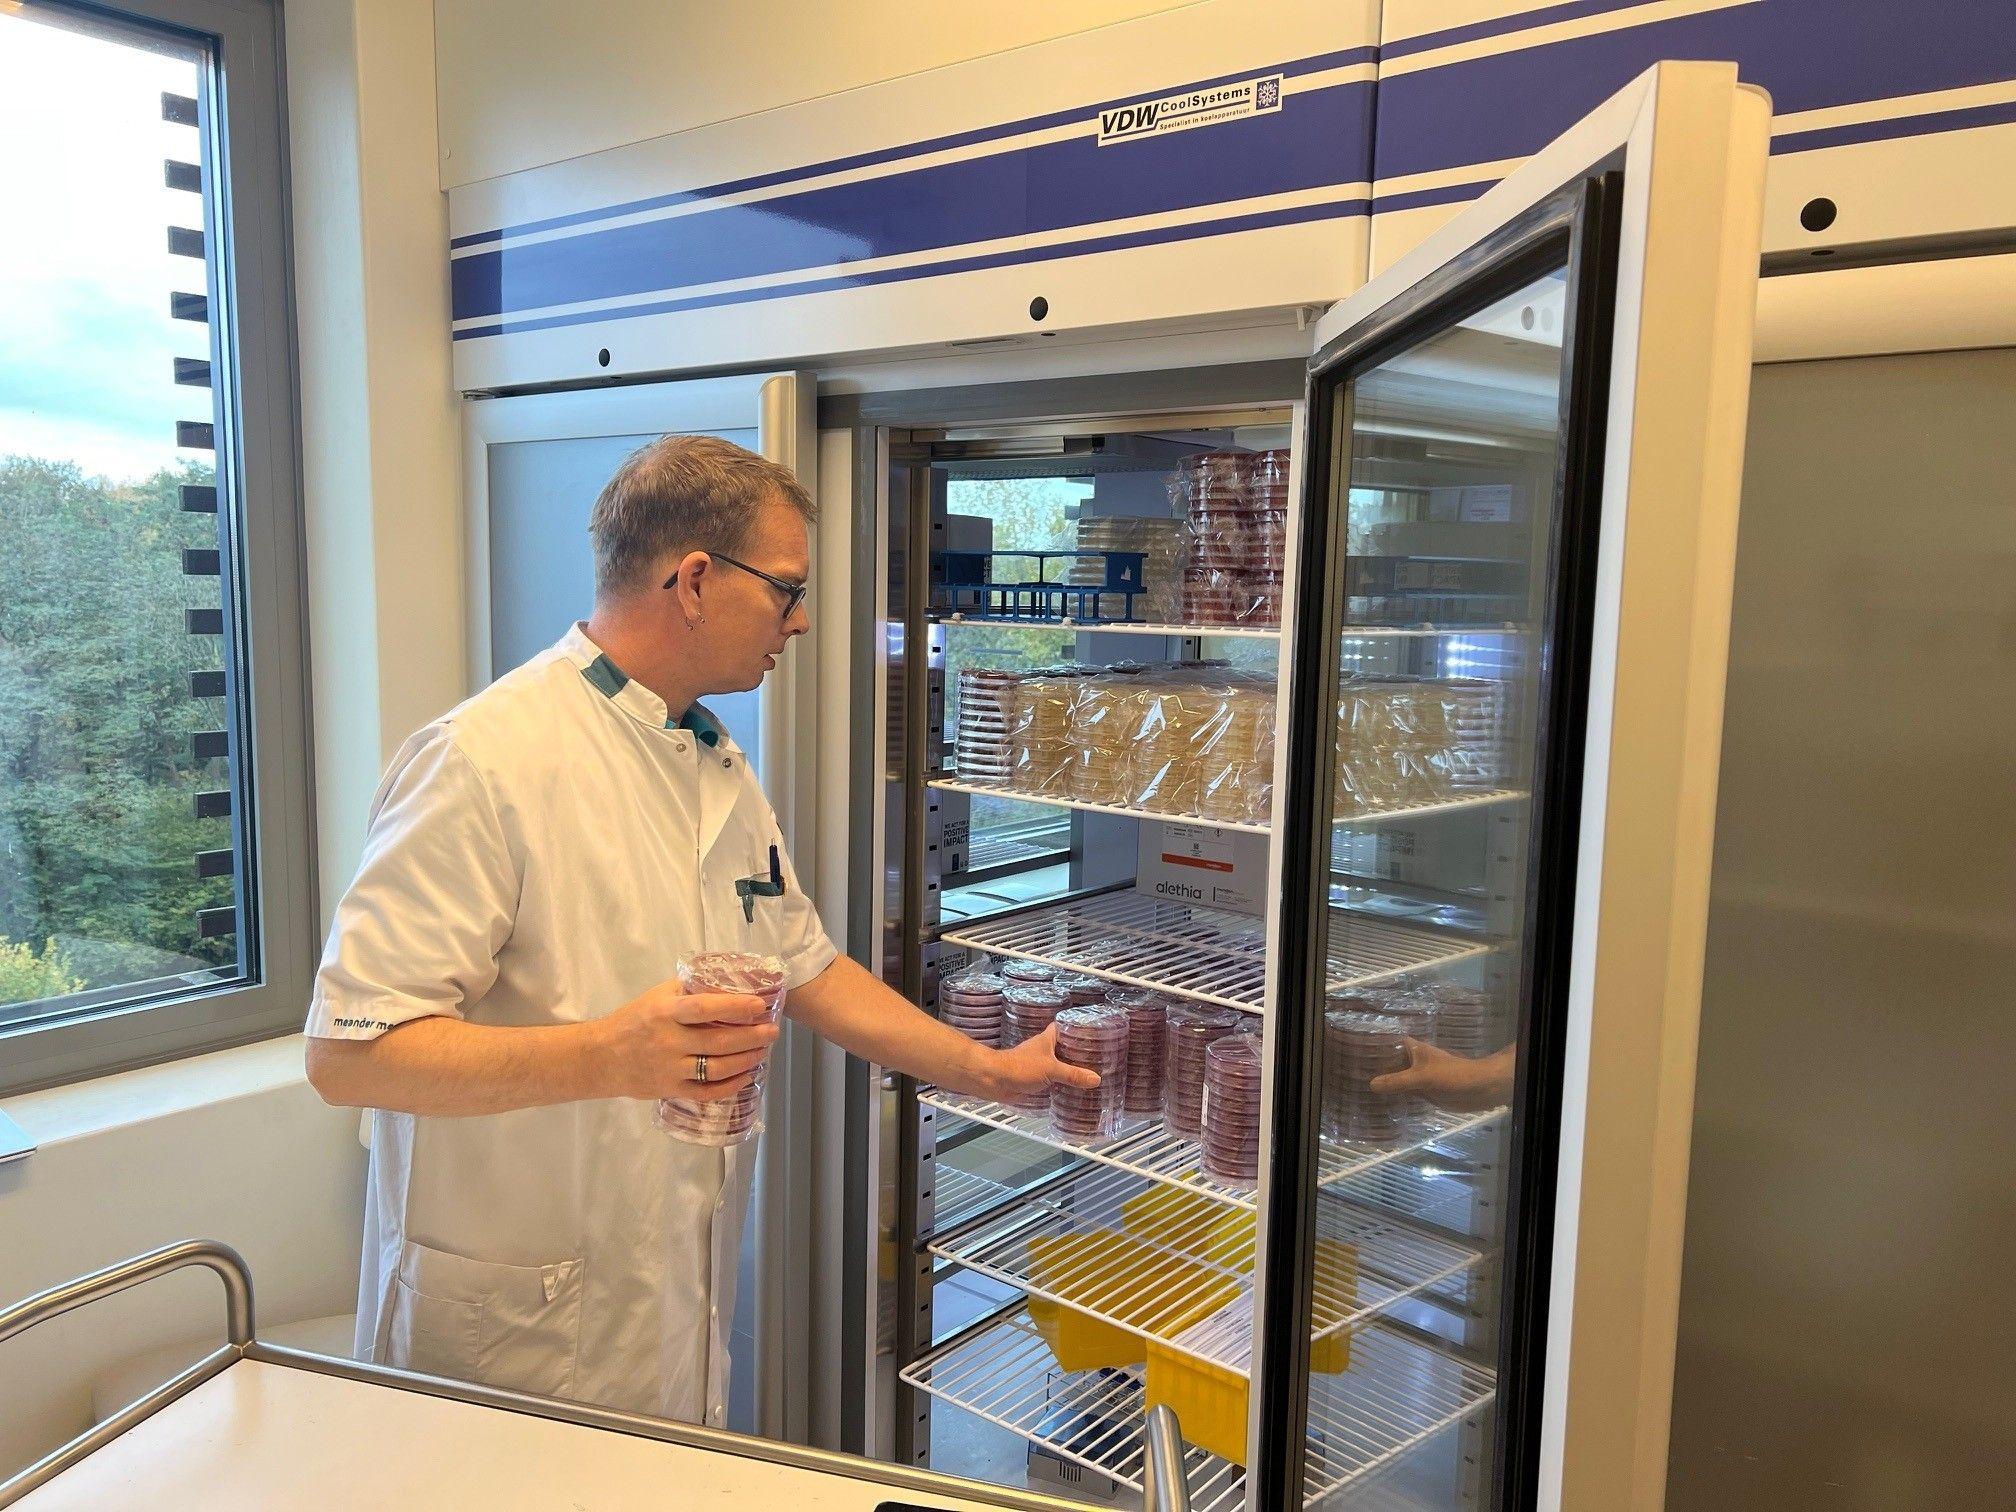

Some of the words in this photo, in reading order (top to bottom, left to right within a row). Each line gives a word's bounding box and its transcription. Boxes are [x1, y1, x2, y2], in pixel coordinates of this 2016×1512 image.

[1102, 103, 1159, 134] VDW
[1160, 86, 1251, 113] CoolSystems
[1159, 118, 1191, 131] Specialist
[1200, 108, 1251, 122] koelapparatuur
[944, 826, 969, 838] POSITIVE
[944, 834, 969, 848] IMPACT
[1156, 881, 1202, 899] alethia
[940, 957, 965, 971] OSITIVE
[334, 1017, 375, 1029] meander
[376, 1022, 394, 1031] me
